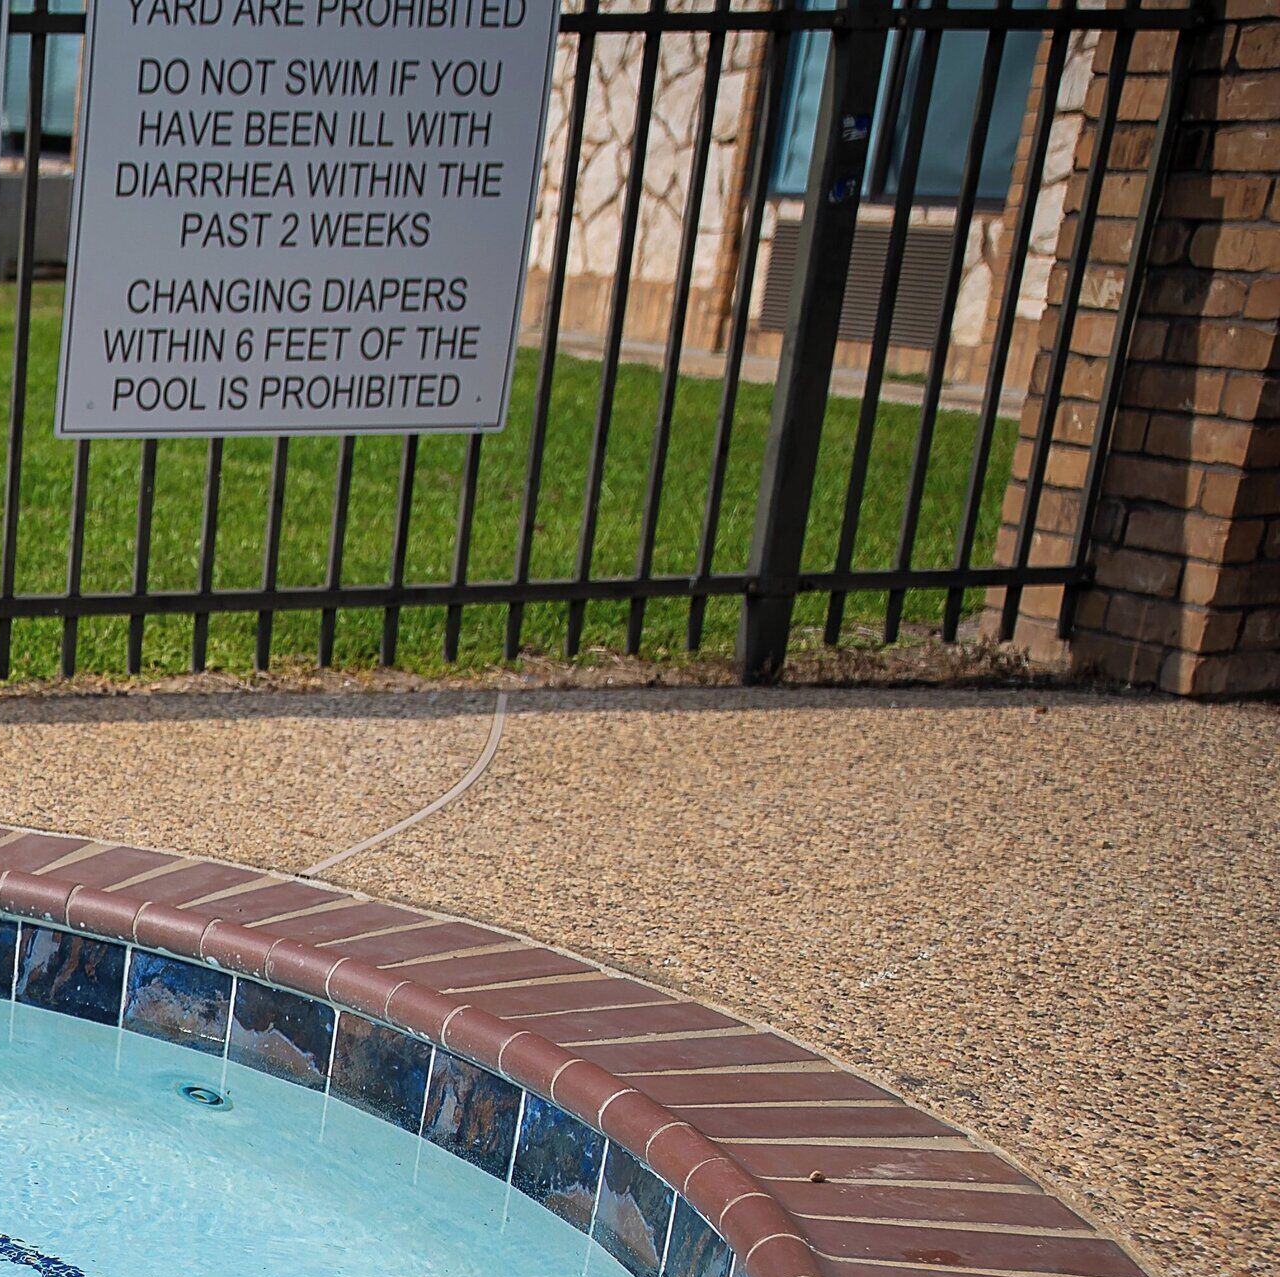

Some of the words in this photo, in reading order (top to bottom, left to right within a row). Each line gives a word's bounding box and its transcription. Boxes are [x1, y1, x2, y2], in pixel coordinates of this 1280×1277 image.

[130, 0, 222, 25] YARD
[232, 0, 304, 26] ARE
[316, 0, 526, 28] PROHIBITED
[137, 58, 189, 95] DO
[201, 58, 276, 95] NOT
[285, 59, 378, 96] SWIM
[389, 59, 420, 96] IF
[431, 60, 502, 96] YOU
[138, 110, 234, 146] HAVE
[244, 110, 338, 147] BEEN
[349, 110, 394, 147] ILL
[407, 111, 492, 147] WITH
[115, 161, 294, 197] DIARRHEA
[307, 161, 426, 197] WITHIN
[437, 162, 504, 197] THE
[180, 212, 272, 248] PAST
[279, 212, 299, 247] 2
[310, 212, 431, 247] WEEKS
[127, 278, 311, 314] CHANGING
[322, 277, 467, 312] DIAPERS
[104, 328, 225, 363] WITHIN
[235, 327, 253, 362] 6
[264, 327, 351, 361] FEET
[360, 326, 406, 361] OF
[416, 325, 480, 360] THE
[112, 376, 205, 411] POOL
[218, 376, 248, 410] IS
[259, 374, 460, 409] PROHIBITED
